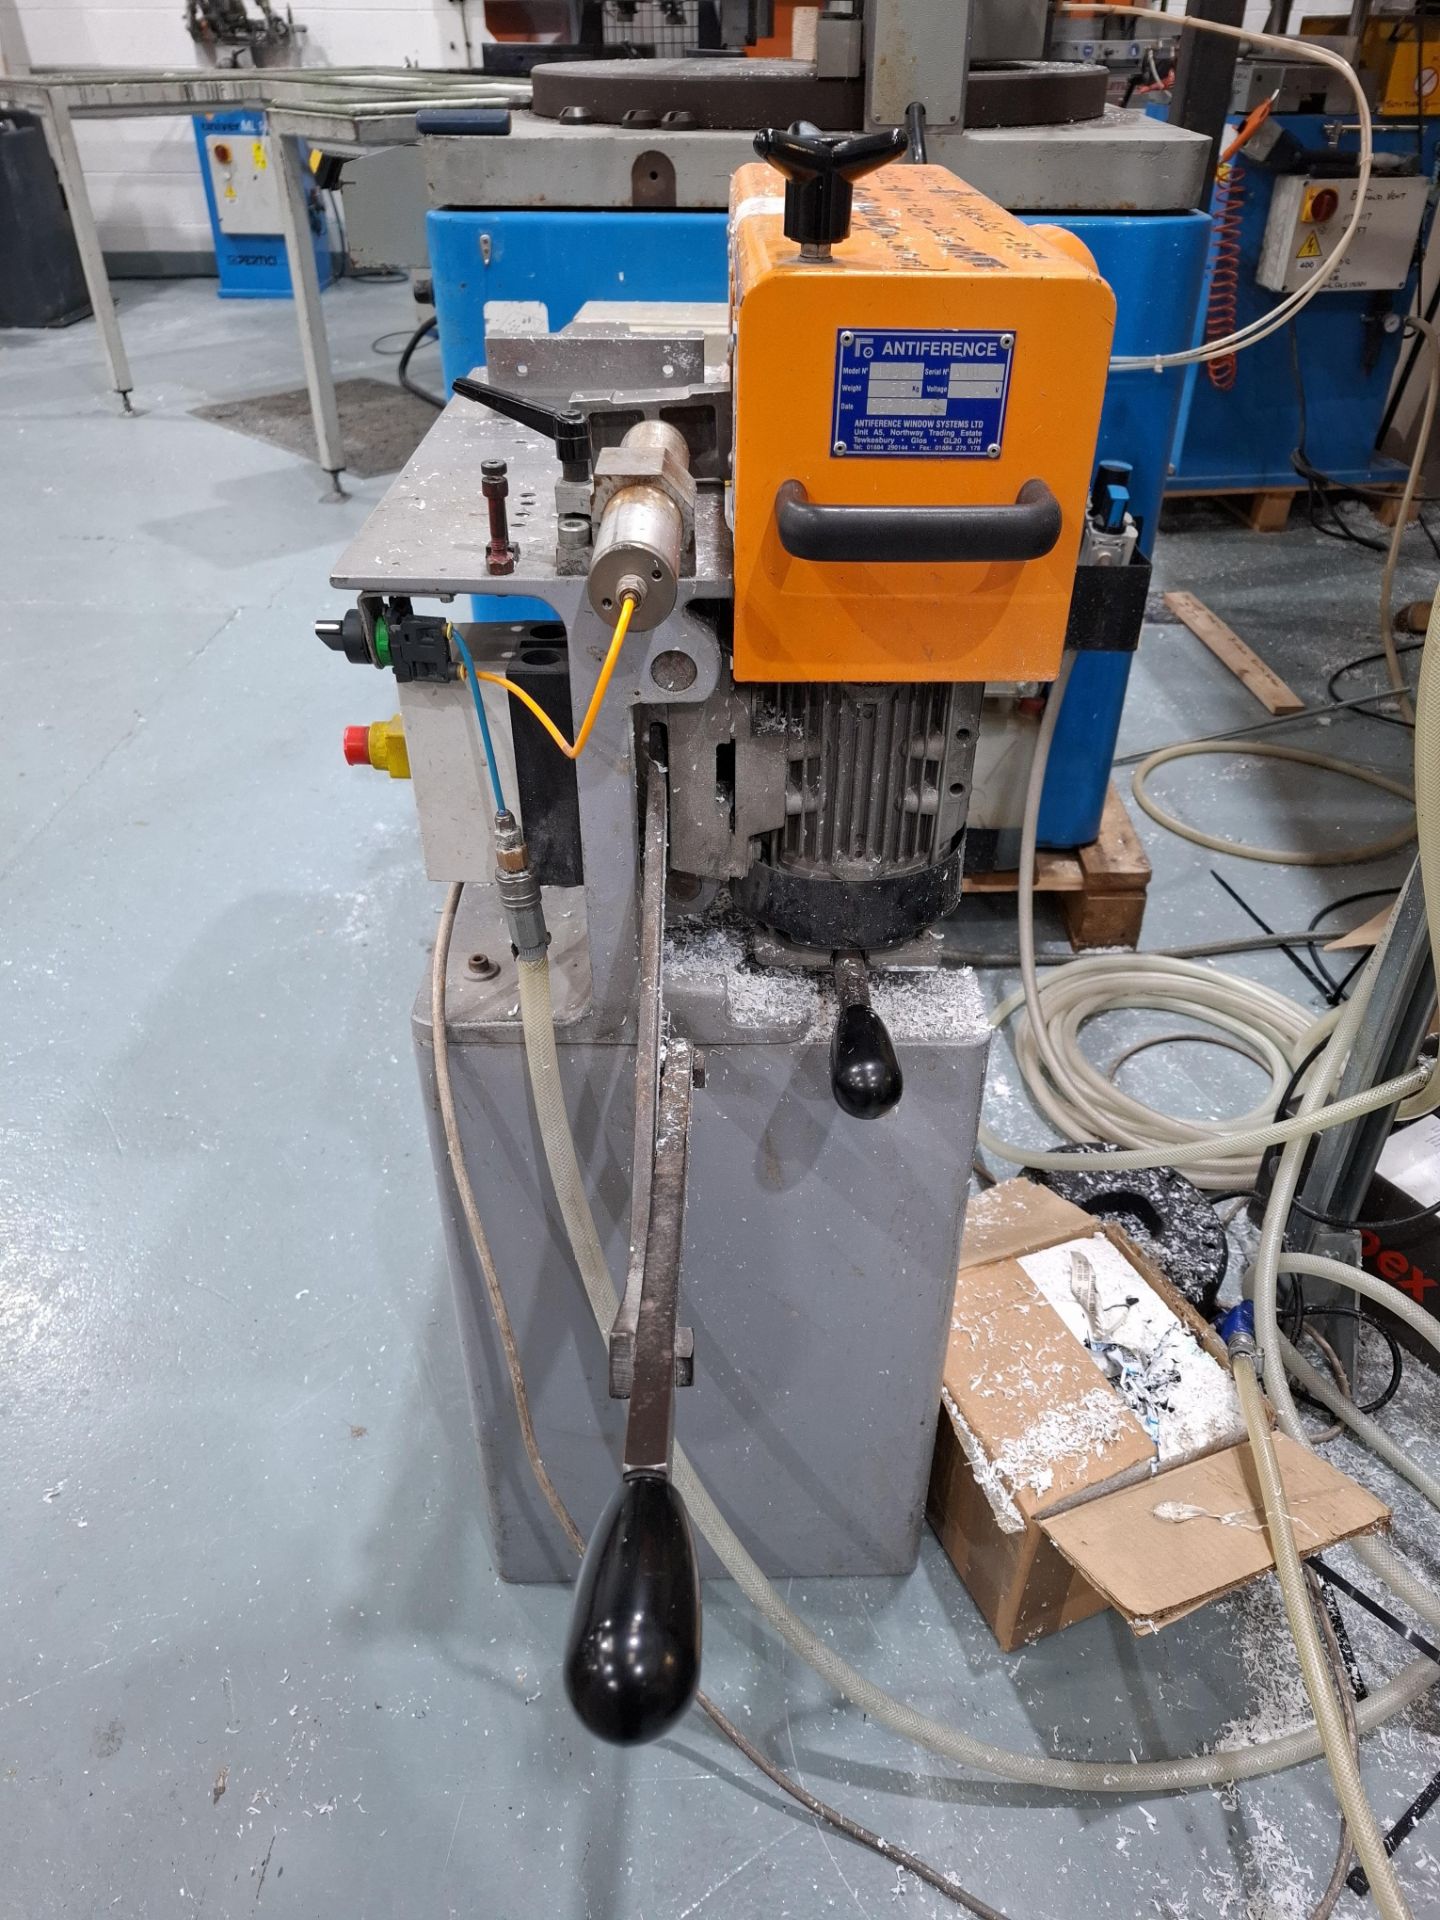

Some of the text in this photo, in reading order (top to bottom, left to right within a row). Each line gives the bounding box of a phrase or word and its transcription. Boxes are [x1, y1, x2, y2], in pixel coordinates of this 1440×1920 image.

[881, 341, 998, 357] ANTIFERENCE
[842, 367, 861, 375] Model
[924, 368, 942, 376] Serial
[841, 384, 862, 393] Weight
[926, 385, 948, 393] Voltage
[840, 402, 854, 410] Date
[854, 419, 984, 428] ANTIFERENCE WINDOW SYSTEMS LTD
[890, 429, 924, 437] Northway
[929, 429, 955, 437] Trading
[960, 429, 983, 437] Estate
[853, 436, 895, 445] Tewkesbury
